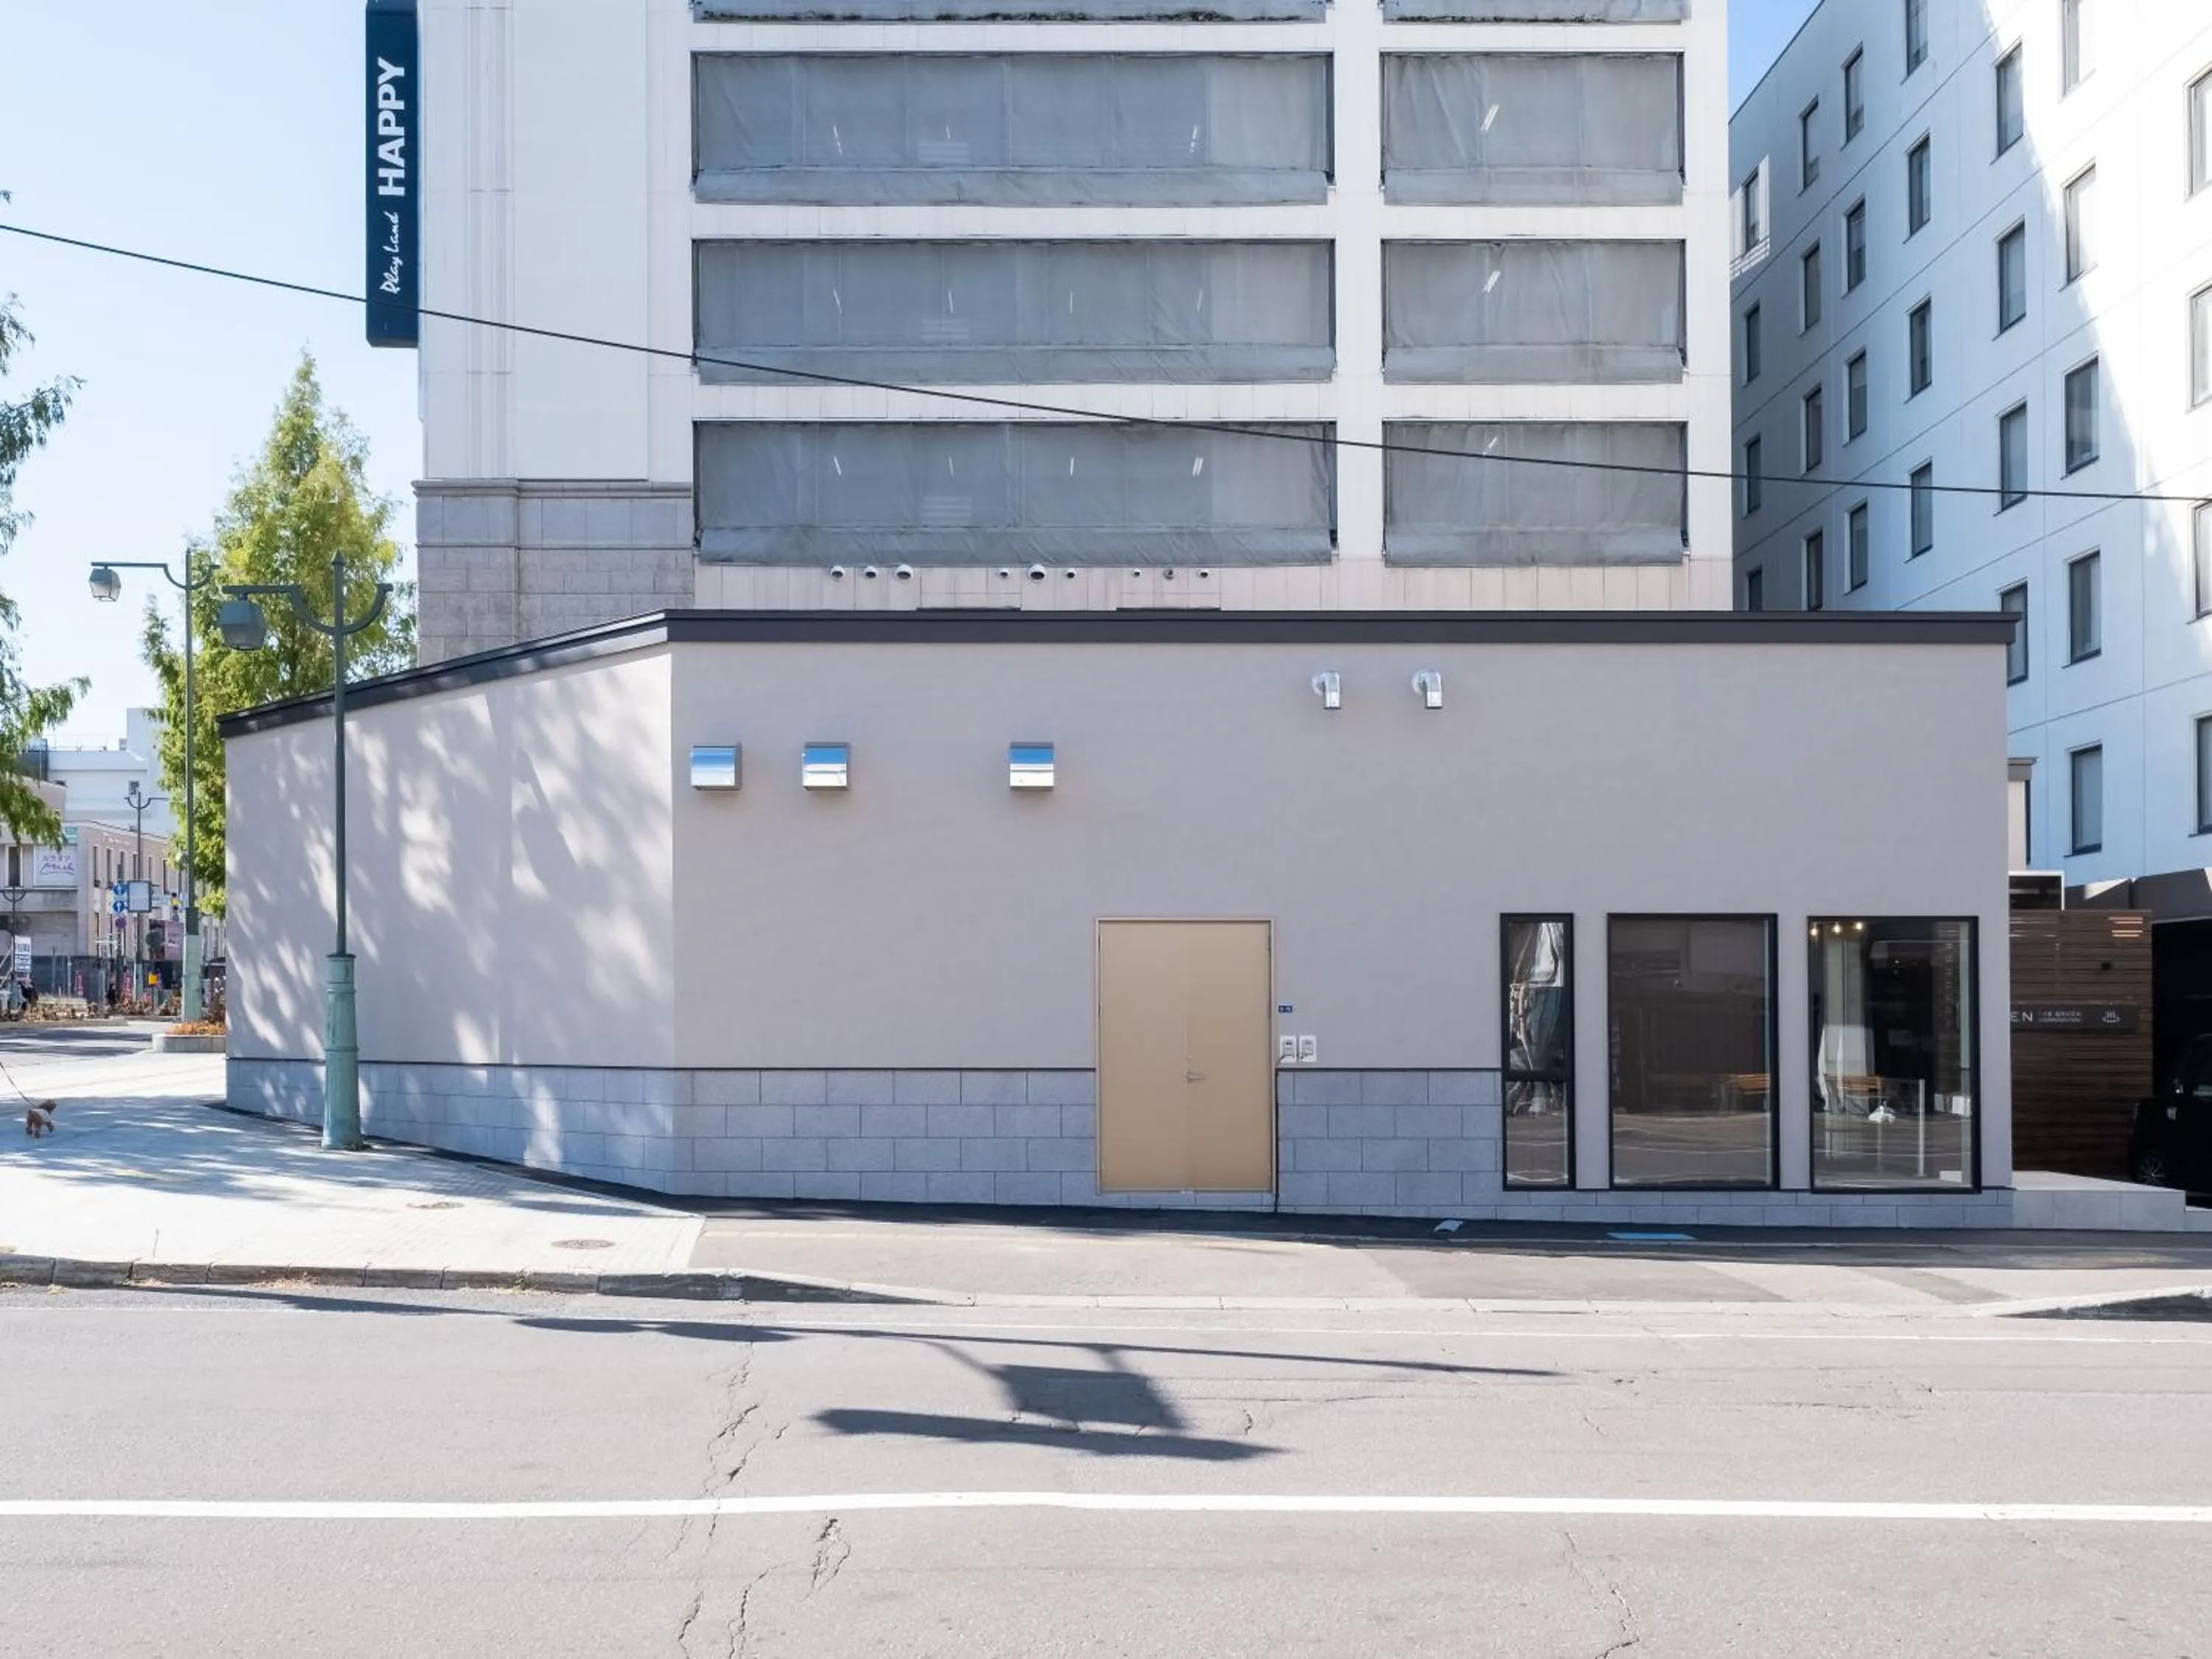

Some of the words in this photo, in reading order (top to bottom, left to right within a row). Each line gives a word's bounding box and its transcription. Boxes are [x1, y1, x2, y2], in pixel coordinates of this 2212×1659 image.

[378, 57, 405, 196] HAPPY
[383, 212, 399, 253] Land
[380, 256, 403, 294] Play
